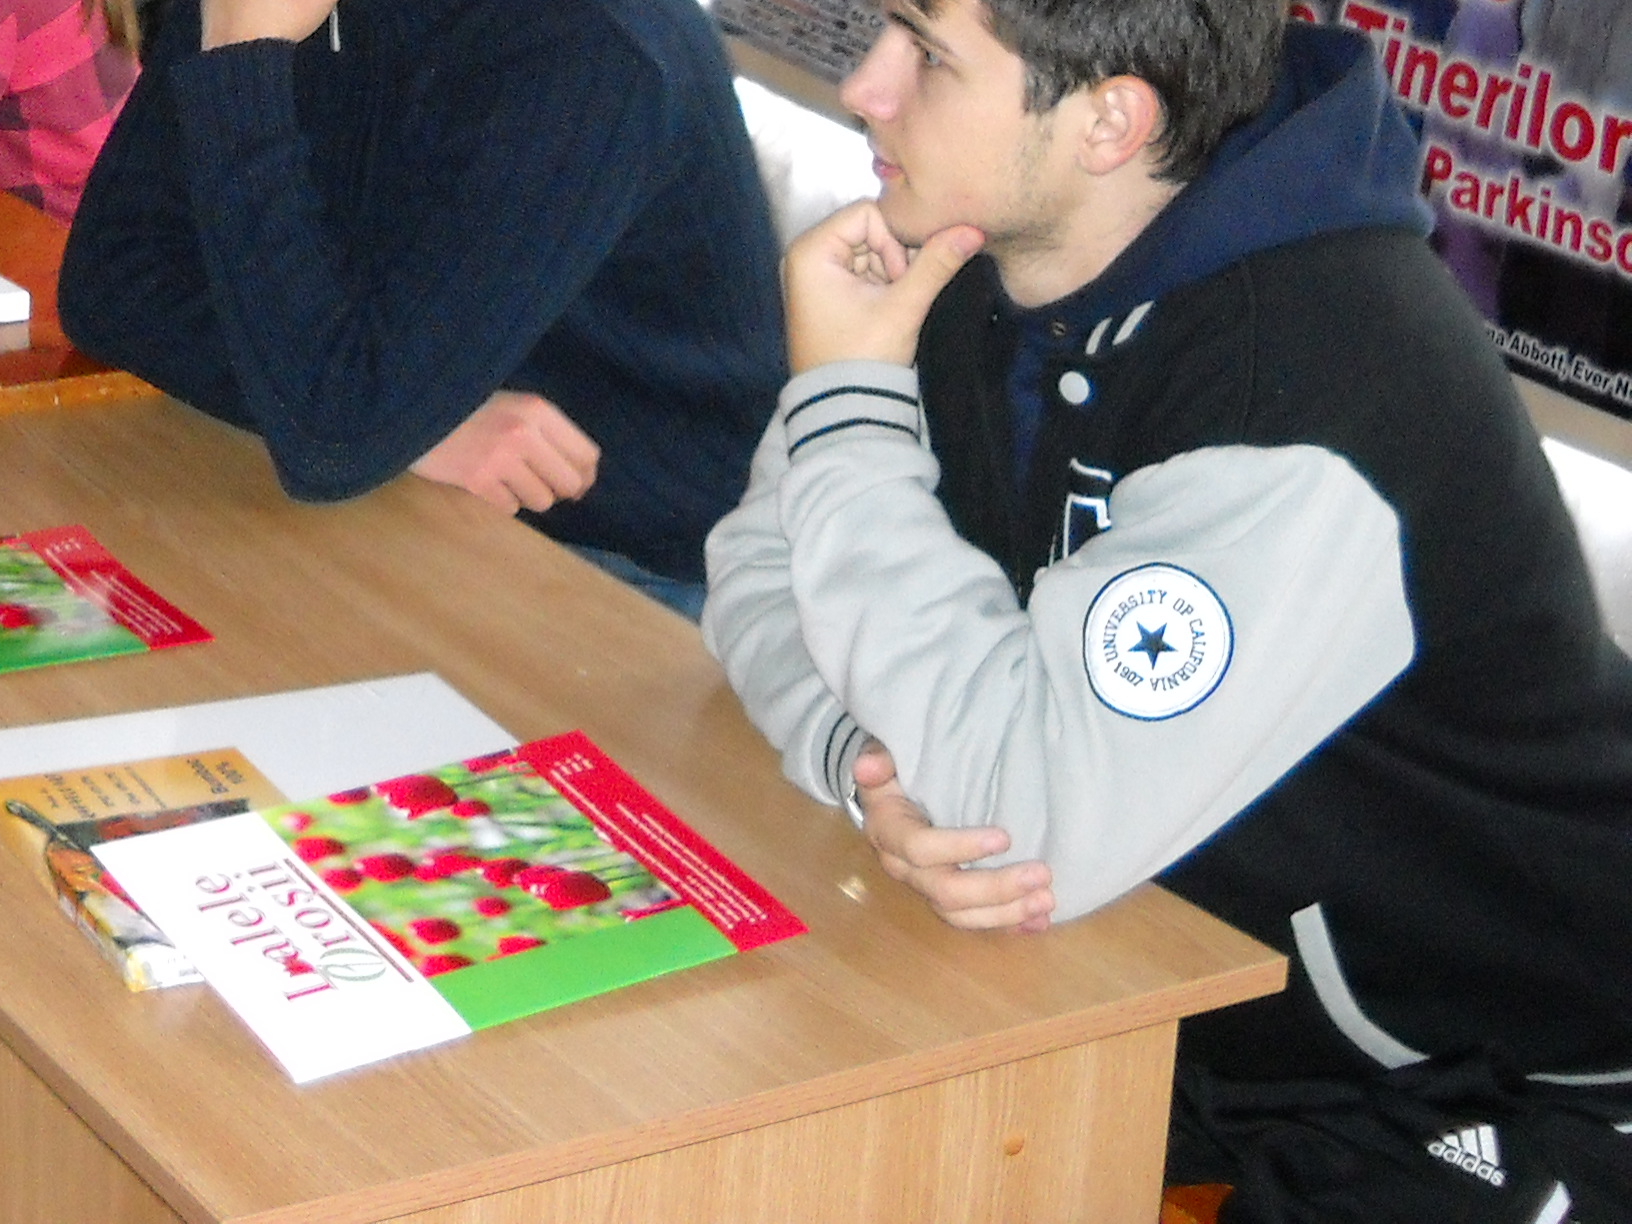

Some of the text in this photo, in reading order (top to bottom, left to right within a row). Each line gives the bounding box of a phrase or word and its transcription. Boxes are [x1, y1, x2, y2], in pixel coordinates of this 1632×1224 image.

[1509, 334, 1567, 377] Abbott,
[1572, 360, 1611, 391] Ever
[1103, 589, 1167, 663] UNIVERSITY
[1149, 618, 1206, 692] CALIFORNIA
[1113, 661, 1144, 687] 1907
[1426, 1139, 1507, 1187] adidas
